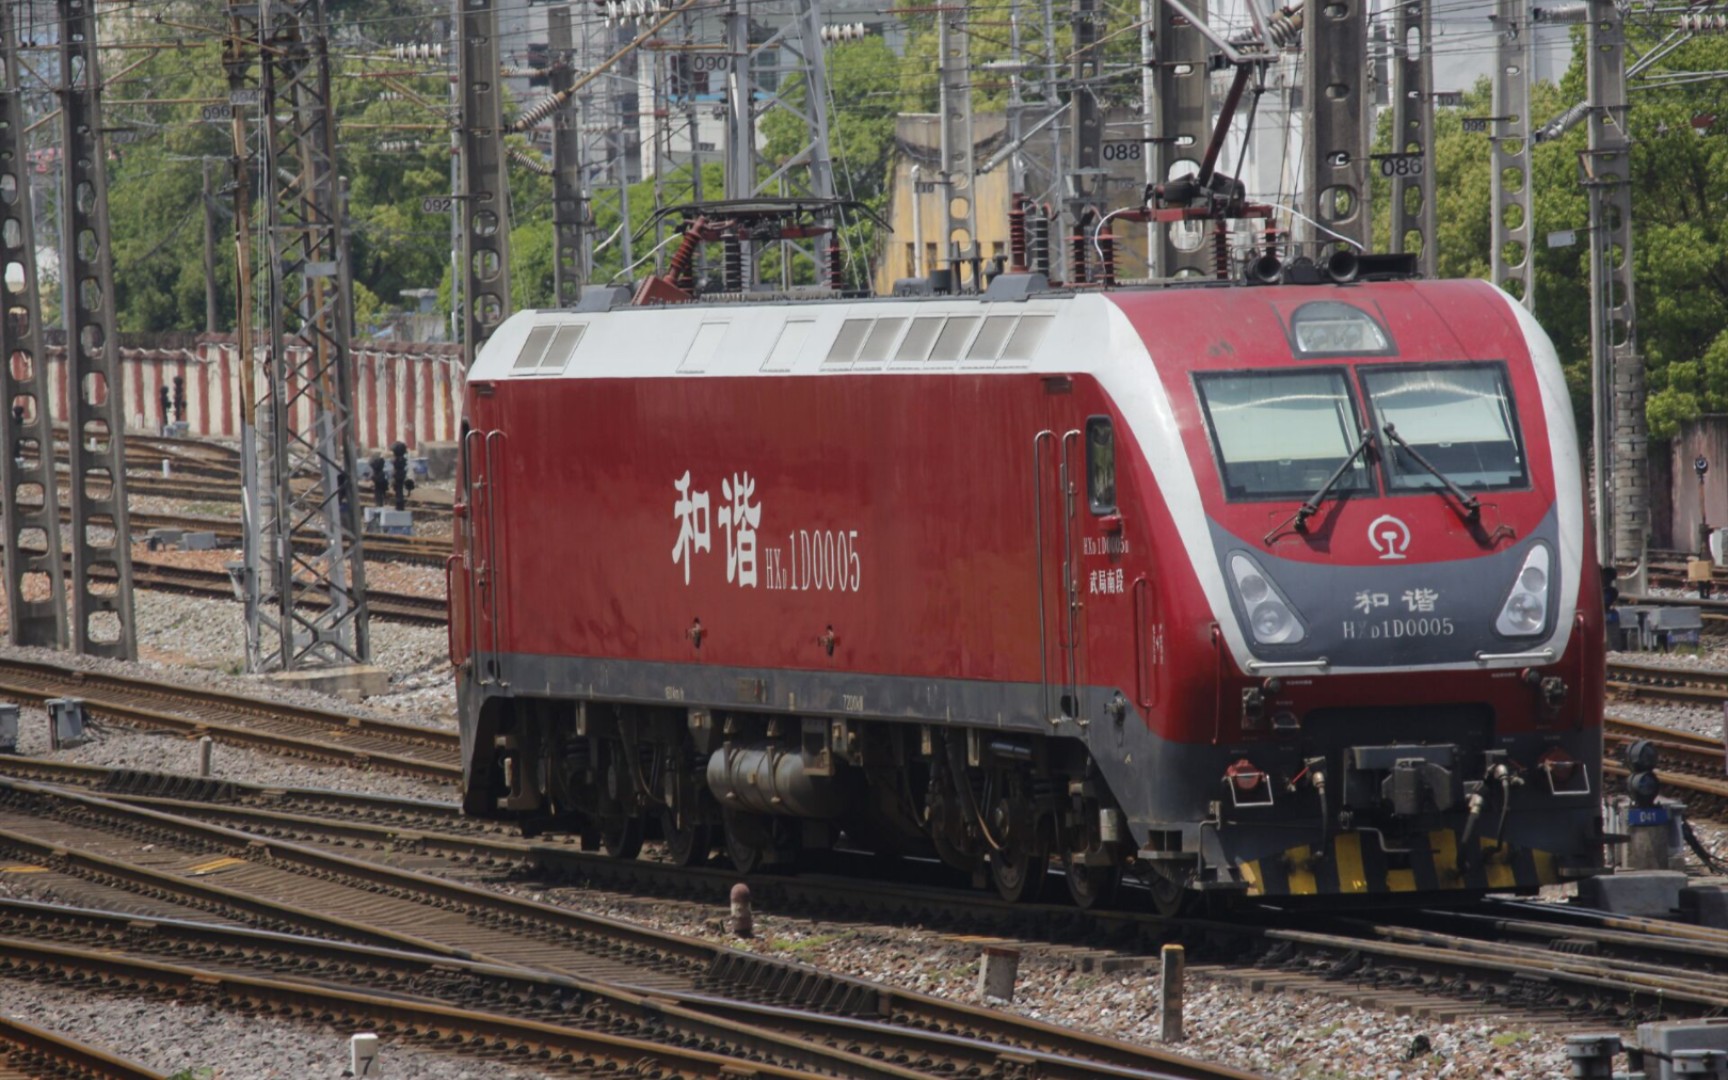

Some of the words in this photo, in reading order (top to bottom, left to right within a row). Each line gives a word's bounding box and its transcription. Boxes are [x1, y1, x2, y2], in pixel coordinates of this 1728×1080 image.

[694, 56, 727, 70] 090
[203, 105, 230, 120] 096
[1103, 143, 1140, 160] 088
[1382, 157, 1422, 176] 086
[423, 199, 451, 211] 092
[672, 469, 761, 588] 和谐
[1353, 588, 1438, 614] 和谐
[360, 1056, 374, 1076] 7
